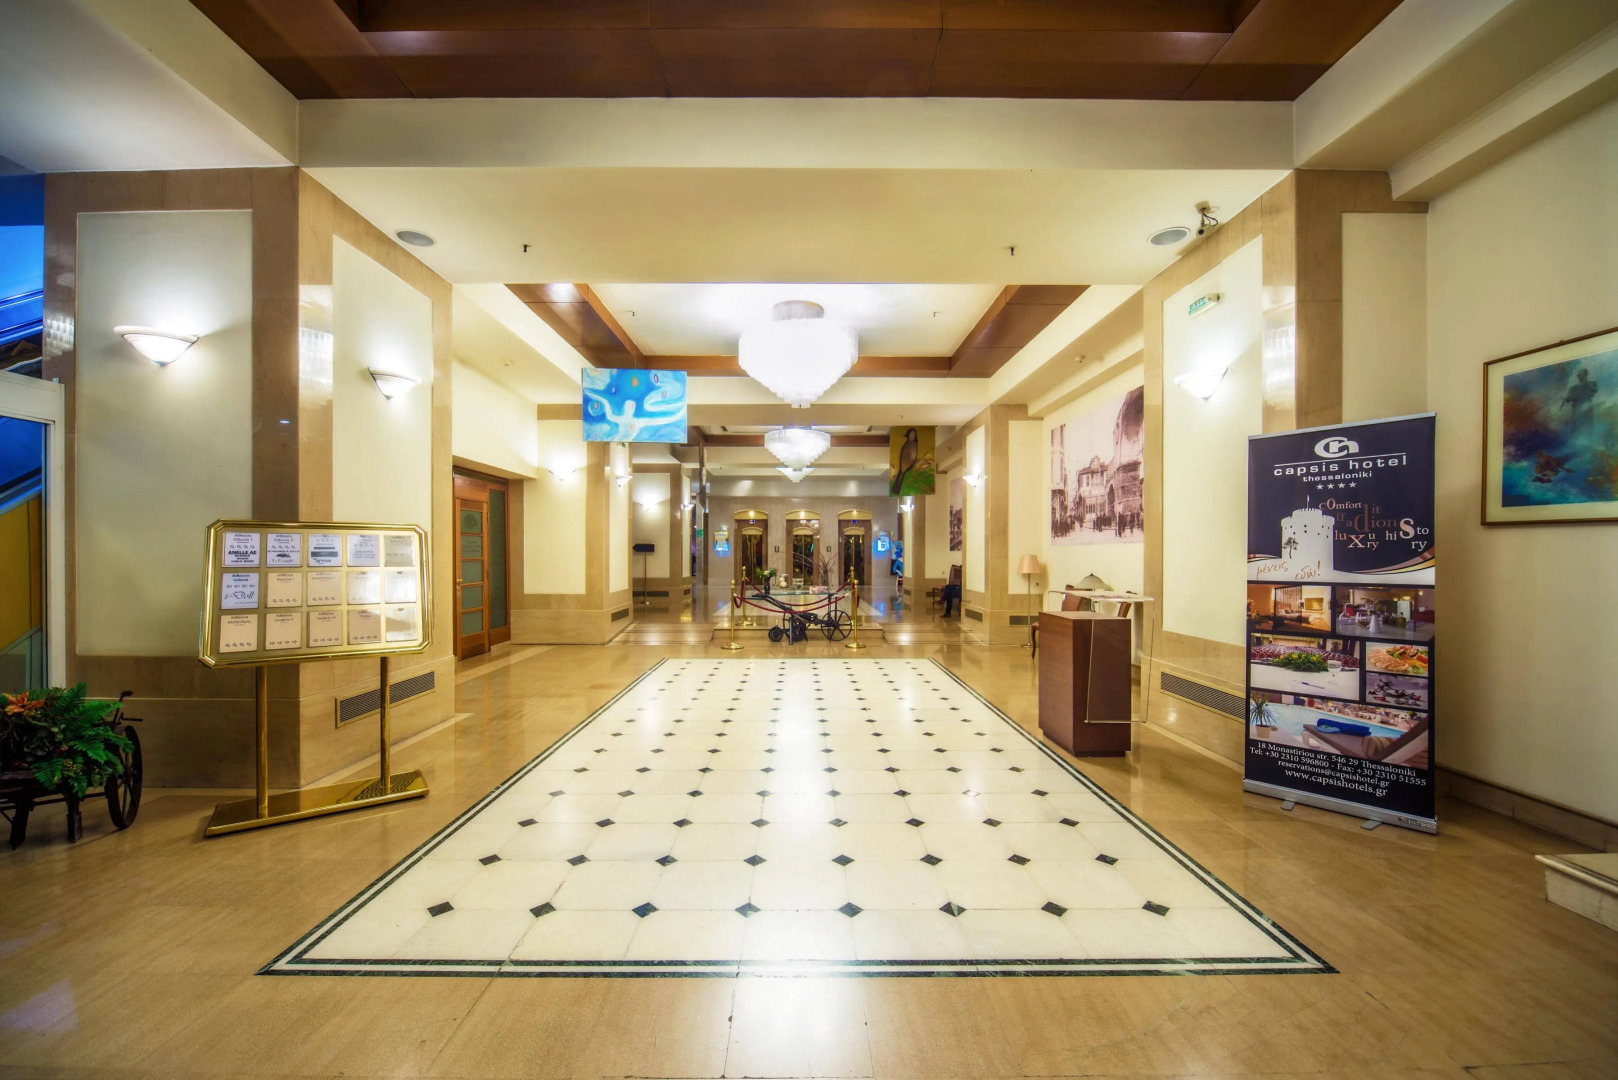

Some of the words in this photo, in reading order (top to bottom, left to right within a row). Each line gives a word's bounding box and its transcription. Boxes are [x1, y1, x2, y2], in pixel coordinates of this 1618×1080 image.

[1274, 462, 1339, 476] capsis
[1349, 455, 1406, 470] hotel
[1303, 471, 1372, 482] thessaloniki
[1250, 747, 1263, 755] Tel:
[1265, 750, 1279, 758] +30
[1281, 754, 1299, 762] 2310
[1301, 757, 1329, 767] 596800
[1337, 763, 1354, 772] Fax:
[1357, 768, 1373, 776] +30
[1375, 771, 1396, 780] 2310
[1399, 775, 1426, 786] 51555
[1268, 744, 1314, 757] Monastiriou
[1332, 755, 1347, 763] 546
[1361, 760, 1416, 777] Thessaloniki
[1278, 760, 1390, 788] reservations@capsishotel.gr
[1285, 769, 1388, 797] www.capsishotels.gr
